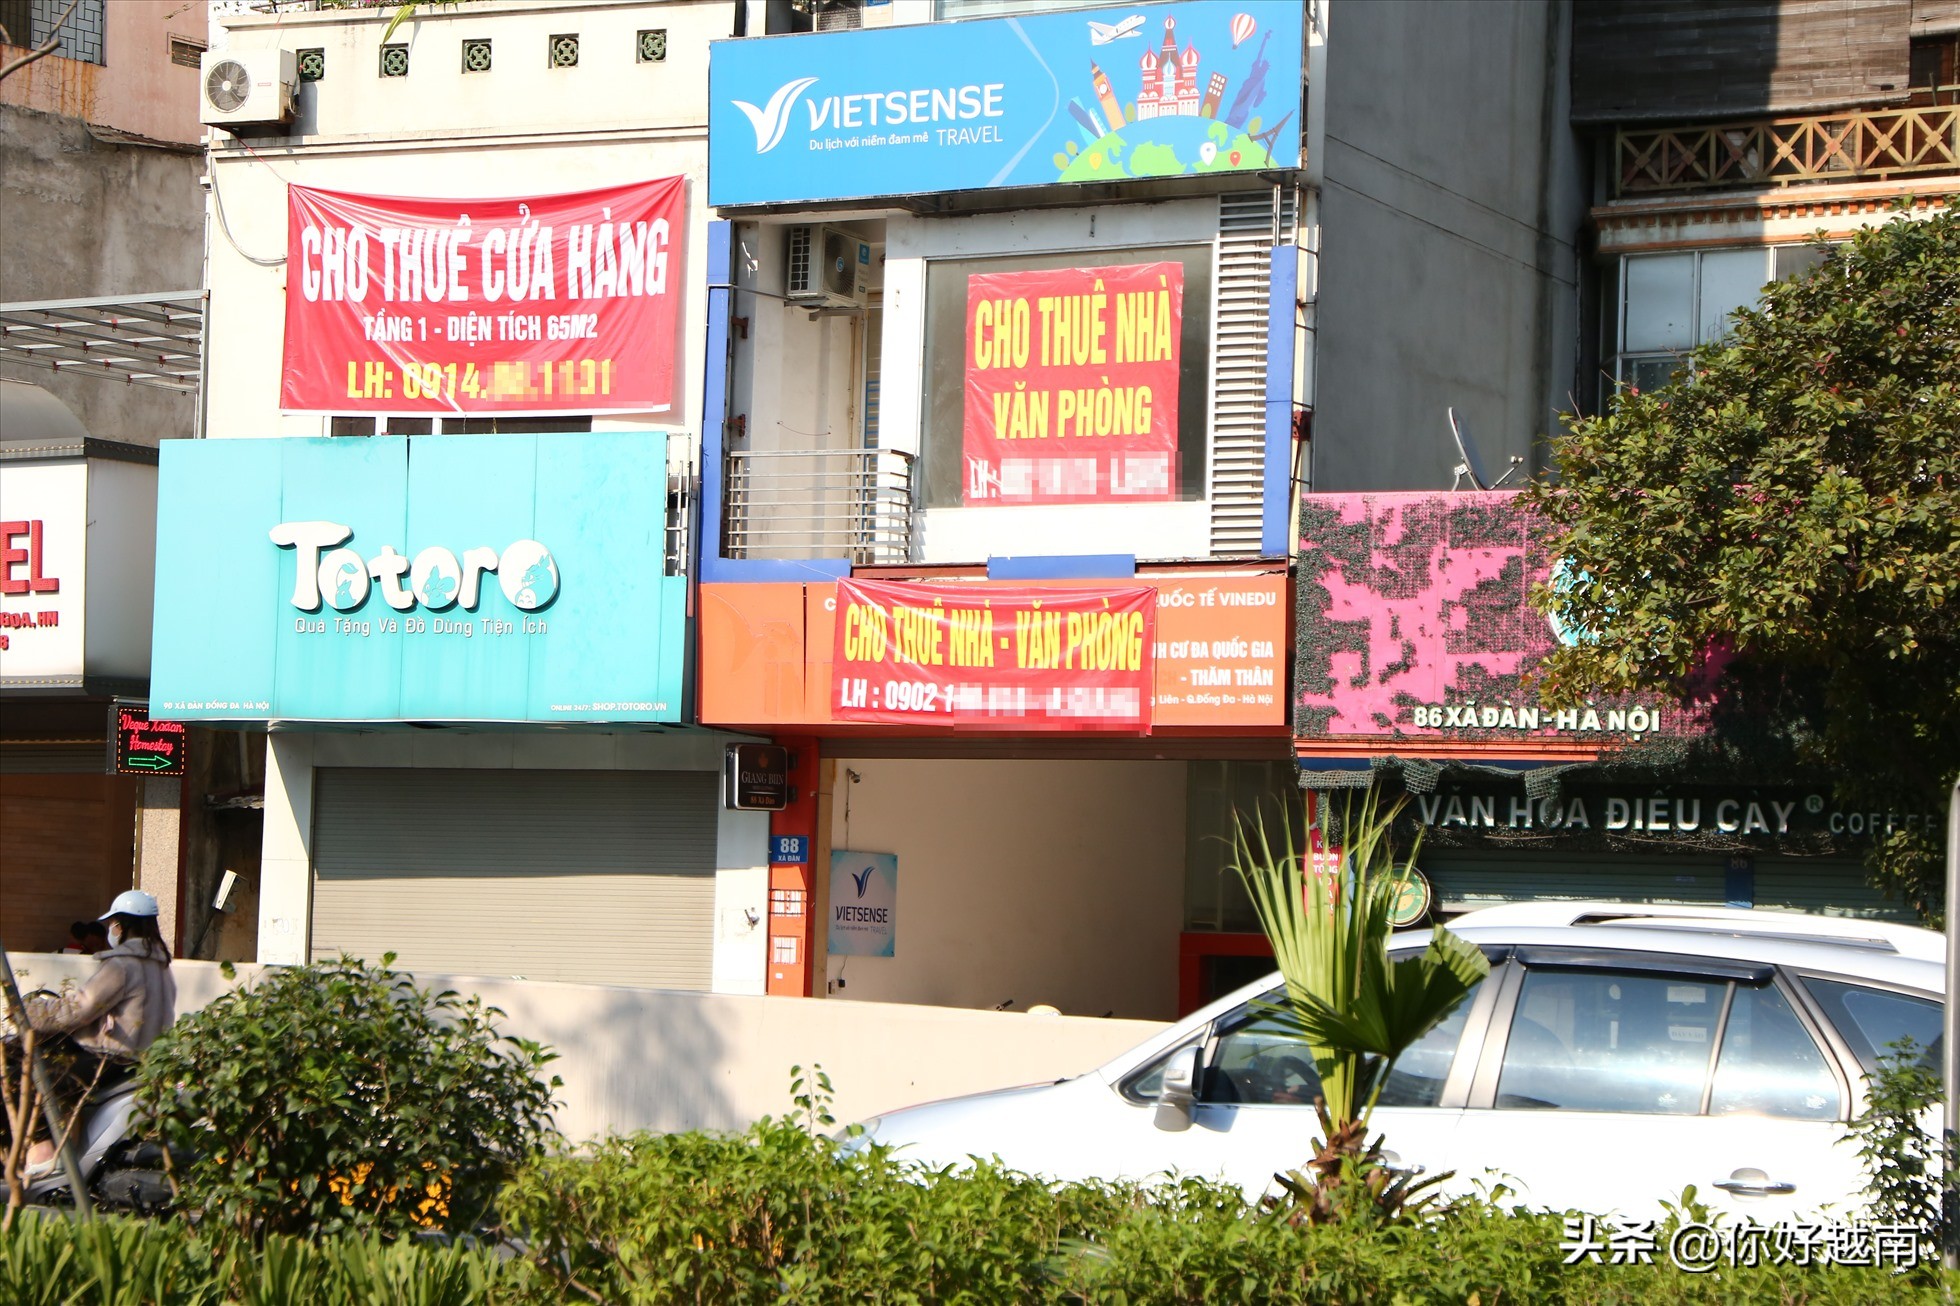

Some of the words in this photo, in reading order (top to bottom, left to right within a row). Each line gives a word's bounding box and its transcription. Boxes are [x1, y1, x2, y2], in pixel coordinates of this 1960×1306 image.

[806, 84, 1004, 132] VIETSENSE
[810, 140, 823, 150] Du
[826, 138, 842, 151] lịch
[844, 136, 859, 148] với
[889, 133, 910, 144] đam
[913, 132, 928, 143] mê
[936, 126, 1003, 146] TRAVEL
[301, 225, 368, 302] CHO
[379, 214, 473, 302] THUÊ
[482, 203, 556, 302] CỬA
[568, 207, 669, 300] HÀNG
[364, 308, 412, 341] TẦNG
[419, 317, 427, 340] 1
[448, 311, 491, 346] DIỆN
[498, 310, 541, 340] TÍCH
[547, 313, 598, 340] 65M2
[975, 298, 1030, 370] CHO
[1038, 279, 1106, 367] THUÊ
[1116, 275, 1172, 363] NHÀ
[347, 361, 393, 398] LH:
[994, 381, 1049, 439] VĂN
[1057, 376, 1152, 437] PHÒNG
[268, 520, 560, 611] Totoro
[1156, 588, 1195, 608] UỐC
[1199, 587, 1218, 607] TẾ
[1219, 592, 1276, 607] VINEDU
[37, 611, 58, 628] HN
[295, 617, 326, 633] Quà
[334, 617, 370, 637] Tặng
[378, 617, 398, 633] Và
[405, 616, 426, 633] Đồ
[433, 617, 473, 637] Dùng
[481, 617, 513, 635] Tiện
[522, 615, 547, 634] Ích
[845, 603, 888, 663] CHO
[892, 598, 945, 666] THUÊ
[950, 599, 994, 668] NHÀ
[1016, 599, 1061, 669] VĂN
[1066, 598, 1143, 672] PHÒNG
[1191, 641, 1209, 659] ĐA
[1212, 635, 1249, 660] QUỐC
[1251, 641, 1274, 659] GIA
[1190, 665, 1231, 686] THĂM
[1234, 665, 1273, 686] THÂN
[243, 700, 254, 709] HÀ
[256, 700, 270, 711] NỘI
[592, 702, 667, 711] SHOP.TOTORO.VN
[841, 678, 867, 708] LH
[885, 681, 936, 712] 0902
[1159, 694, 1179, 704] Liên
[1243, 694, 1255, 704] Hà
[1258, 694, 1273, 706] Nội
[1608, 706, 1660, 741] NỘI
[129, 733, 173, 756] Homestay
[741, 771, 767, 784] GIANG
[1418, 785, 1495, 828] VĂN
[1605, 785, 1700, 832] ĐIẾU
[780, 838, 799, 853] 88
[836, 906, 888, 923] VIETSENSE
